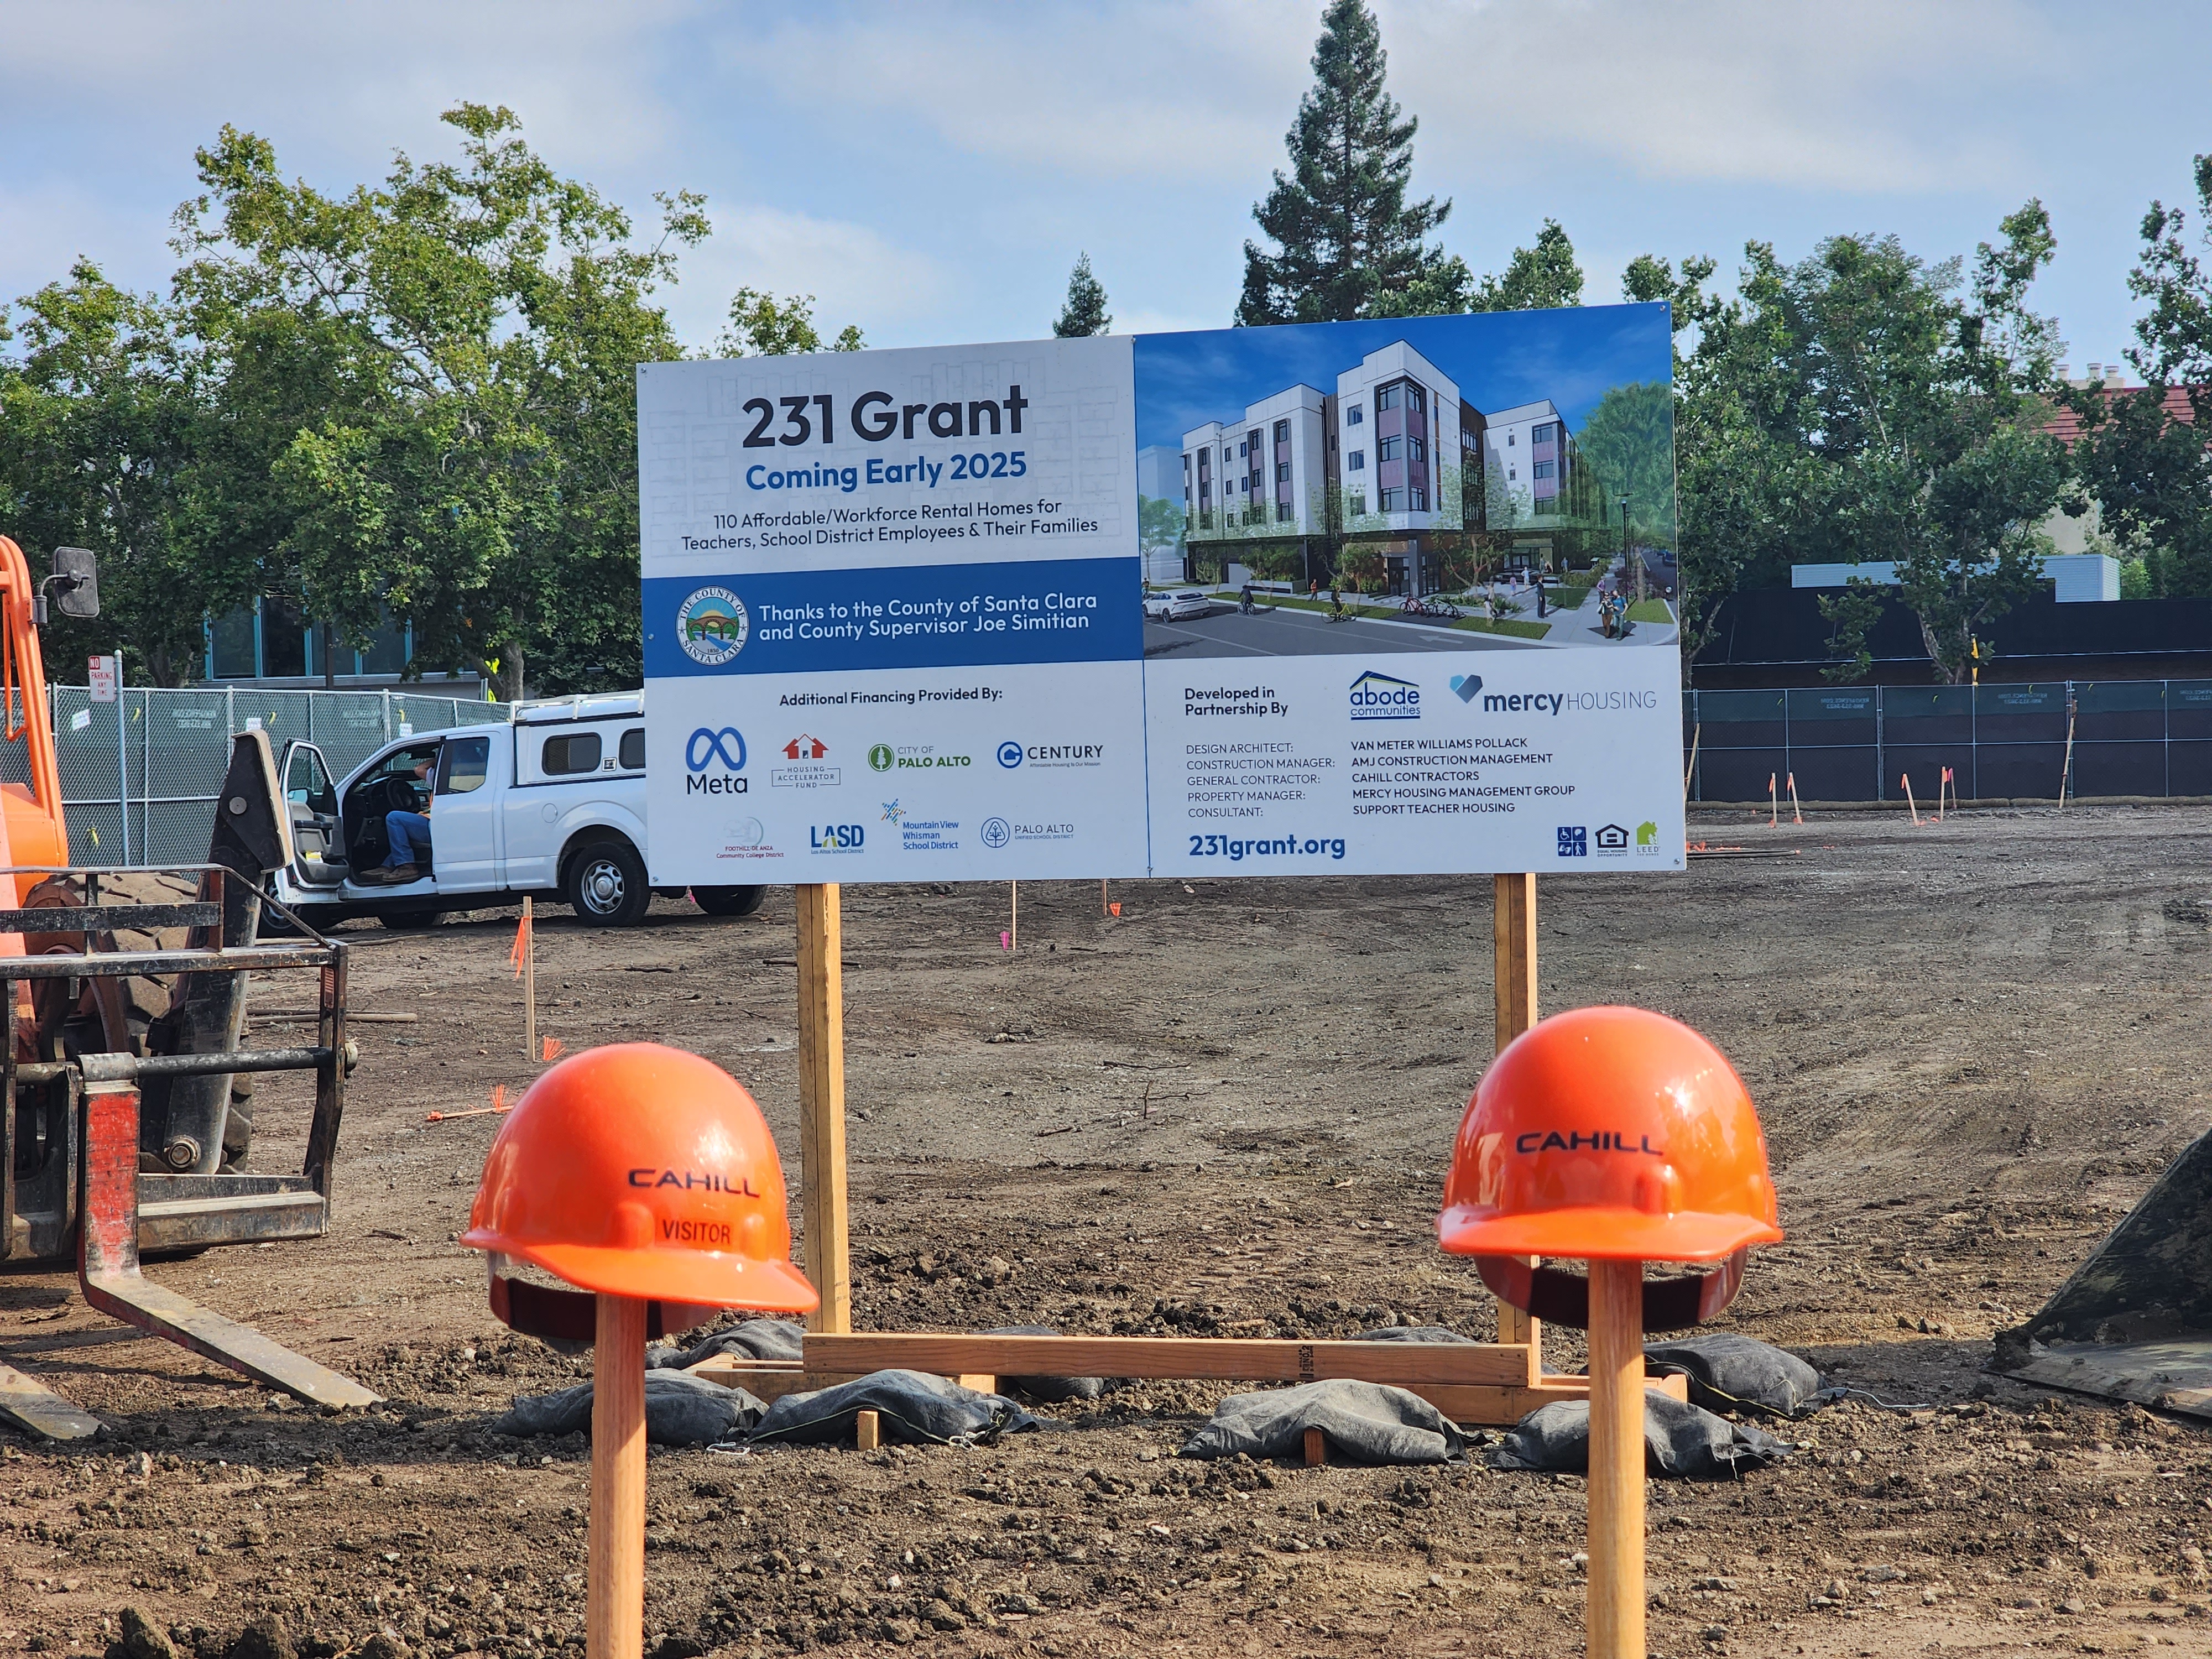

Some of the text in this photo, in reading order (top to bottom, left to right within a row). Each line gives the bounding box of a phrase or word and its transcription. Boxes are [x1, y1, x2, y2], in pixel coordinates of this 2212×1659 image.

[742, 384, 1029, 448] 231 Grant
[746, 451, 1026, 493] Coming Early 2025
[713, 498, 1062, 529] 110 Affordable/Workforce Rental Homes for
[681, 517, 1098, 550] Teachers, School District Employees & Their Families
[680, 588, 746, 620] THE COUNTY OF
[759, 592, 1097, 622] Thanks to the County of Santa Clara
[759, 612, 1089, 641] and County Supervisor Joe Simitian
[682, 639, 744, 662] SANTA CLARA
[90, 658, 100, 668] NO
[779, 687, 1003, 706] Additional Financing Provided By:
[1185, 686, 1275, 702] Developed in
[1350, 681, 1420, 706] abode
[1185, 702, 1288, 717] Partnership By
[1350, 705, 1421, 716] communities
[1484, 691, 1656, 716] mercy HOUSING
[898, 745, 934, 754] CITY OF
[1186, 743, 1293, 754] DESIGN ARCHITECT:
[1350, 738, 1528, 751] VAN METER WILLIAMS POLLACK
[1027, 745, 1103, 760] CENTURY
[1351, 753, 1553, 767] AMJ CONSTRUCTION MANAGEMENT
[898, 756, 971, 768] PALO ALTO
[1186, 758, 1335, 770] CONSTRUCTION MANAGER:
[1187, 774, 1320, 786] GENERAL CONTRACTOR:
[1352, 771, 1479, 782] CAHILL CONTRACTORS
[686, 774, 748, 795] Meta
[1353, 785, 1575, 799] MERCY HOUSING MANAGEMENT GROUP
[1188, 790, 1306, 802] PROPERTY MANAGER:
[1188, 807, 1263, 818] CONSULTANT:
[1353, 802, 1515, 815] SUPPORT TEACHER HOUSING
[903, 821, 959, 830] Mountain View
[1015, 824, 1074, 834] PALO ALTO
[811, 825, 864, 848] LASD
[902, 831, 940, 840] Whisman
[903, 841, 958, 850] School District
[1189, 834, 1345, 861] 231grant.org
[1515, 1130, 1664, 1156] CAHILL
[628, 1168, 761, 1199] CAHILL
[662, 1219, 731, 1245] VISITOR
